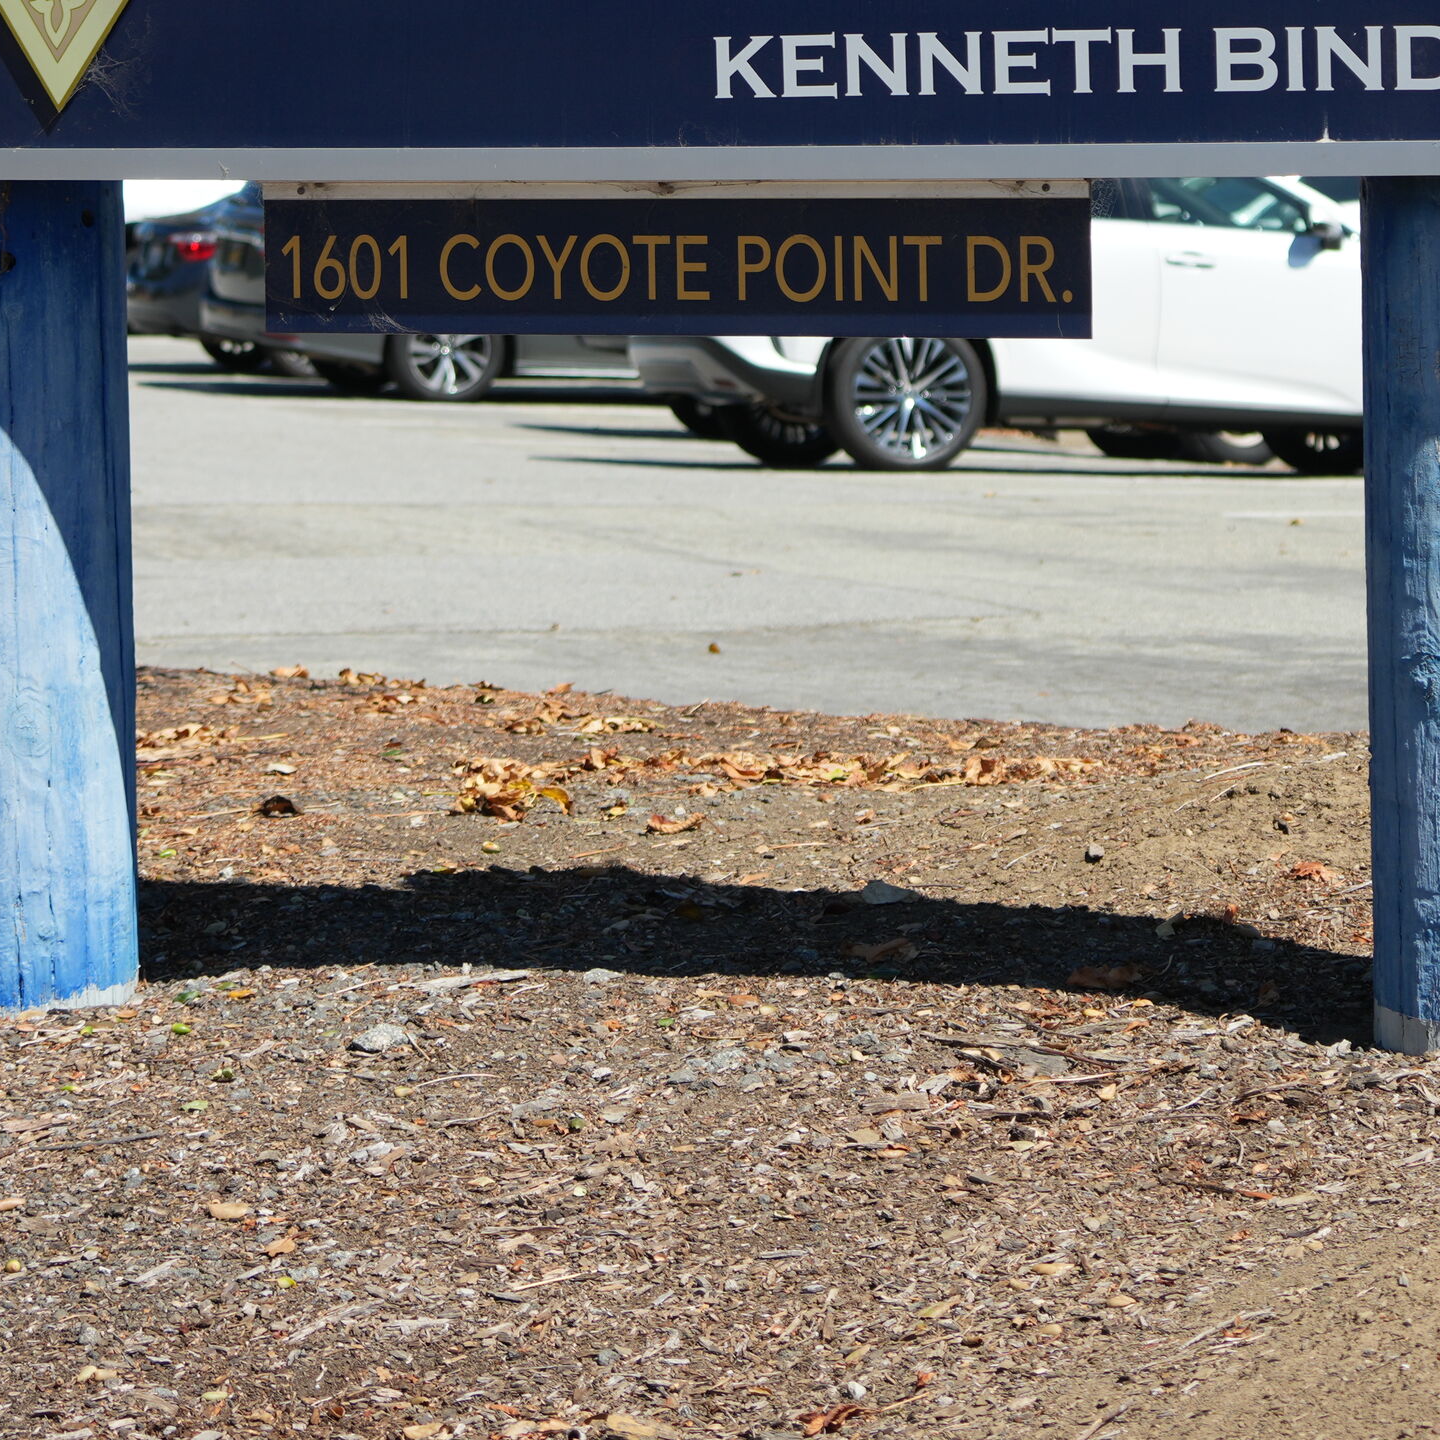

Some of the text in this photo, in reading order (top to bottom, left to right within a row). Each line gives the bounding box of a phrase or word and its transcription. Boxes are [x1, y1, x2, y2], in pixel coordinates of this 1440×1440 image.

[713, 26, 1184, 100] KENNETH
[281, 233, 1073, 303] 1601 COYOTE POINT DR.
